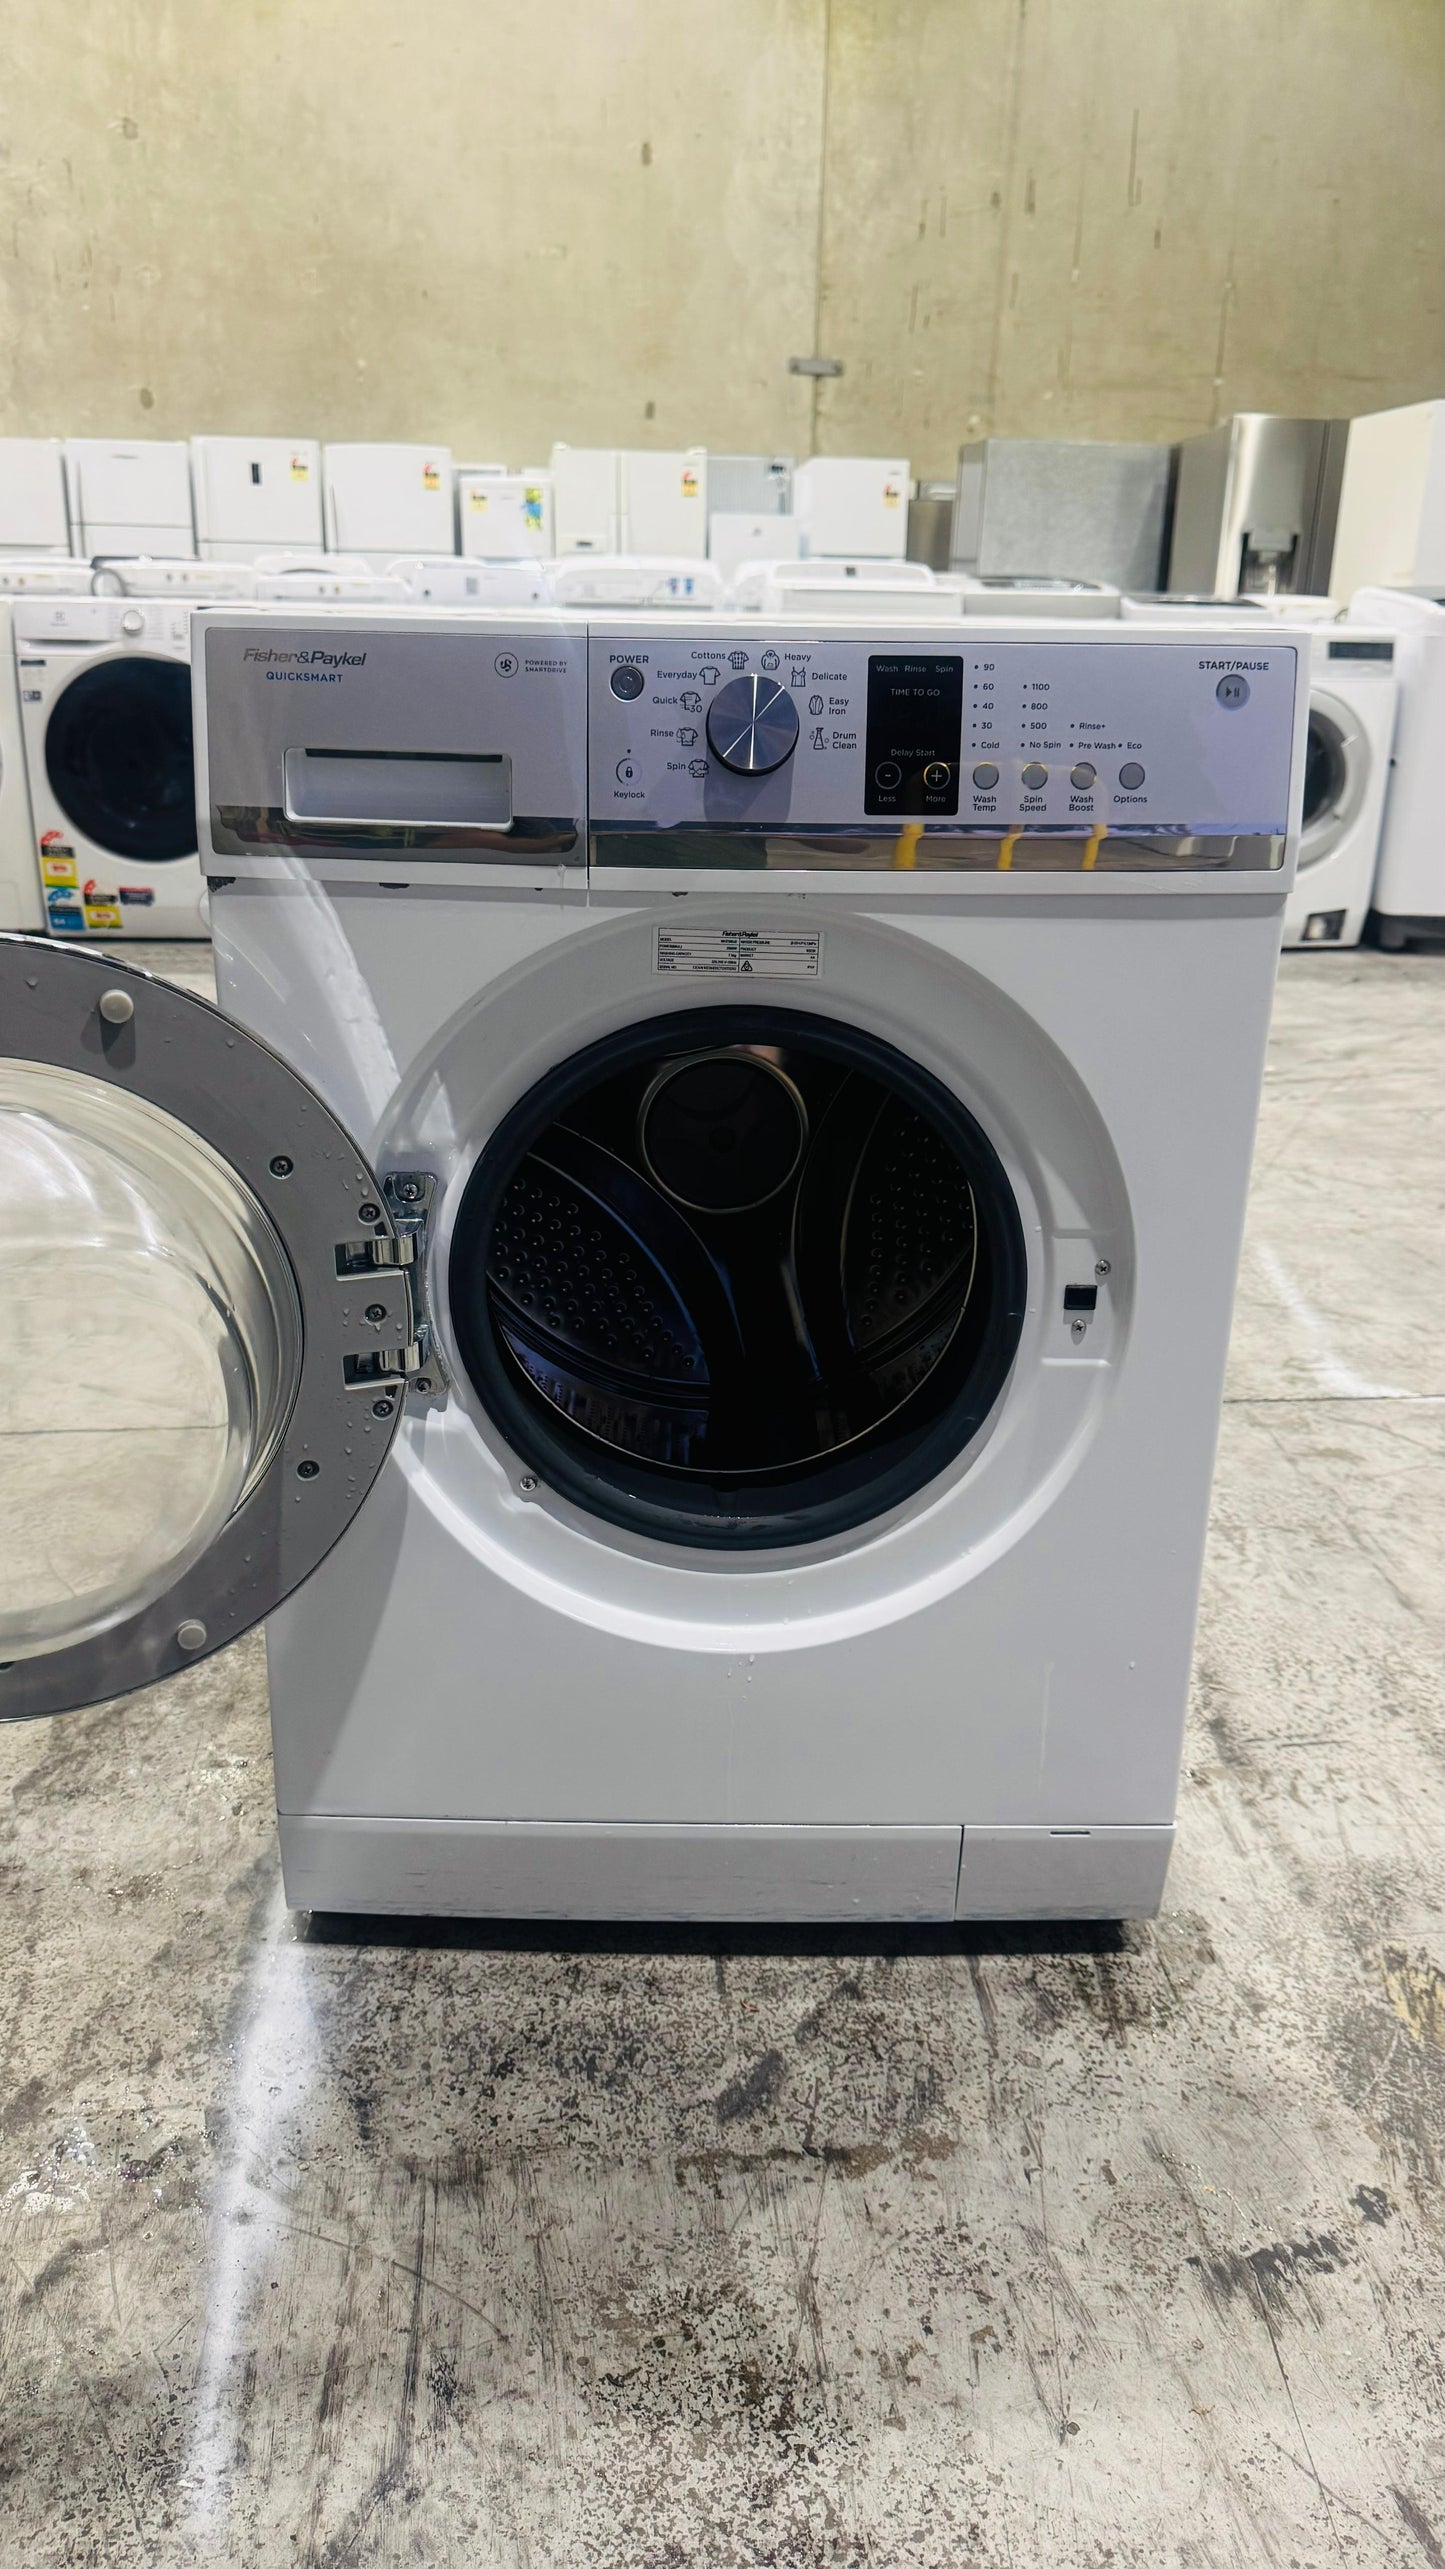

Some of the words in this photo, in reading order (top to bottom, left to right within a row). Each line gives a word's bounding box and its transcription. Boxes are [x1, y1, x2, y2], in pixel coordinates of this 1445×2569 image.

[609, 655, 650, 664] POWER
[691, 651, 726, 661] Cottons
[784, 653, 812, 663] Heavy
[876, 664, 899, 673] Wash
[904, 664, 927, 673] Rinse
[935, 664, 954, 675] Spin
[983, 663, 995, 671] 90
[1198, 661, 1270, 671] START/PAUSE
[266, 671, 344, 683] QUICKSMART
[657, 670, 698, 681] Everyday
[811, 672, 848, 681] Delicate
[982, 683, 994, 691] 60
[1031, 683, 1050, 691] 1100
[890, 688, 911, 697] TIME
[913, 688, 925, 697] TO
[926, 688, 940, 697] GO
[652, 696, 678, 705] Quick
[829, 697, 850, 708] Easy
[982, 702, 994, 710] 40
[1030, 702, 1048, 710] 800
[829, 707, 846, 715] Iron
[981, 721, 993, 730] 30
[1030, 721, 1048, 730] 500
[650, 729, 674, 738] Rinse
[832, 731, 857, 740] Drum
[832, 741, 857, 750] Clean
[981, 740, 1000, 749] Cold
[1029, 740, 1044, 749] No
[1043, 741, 1062, 751] Spin
[890, 748, 912, 759] Delay
[915, 748, 936, 758] Start
[667, 762, 686, 772] Spin
[613, 790, 646, 800] Keylock
[878, 795, 897, 803] Less
[925, 795, 946, 803] More
[972, 795, 997, 803] Wash
[1070, 795, 1094, 803] Wash
[1113, 795, 1148, 804] Options
[1023, 795, 1043, 805] Spin
[972, 803, 997, 813] Temp
[1019, 803, 1047, 813] Speed
[1068, 804, 1094, 812] Boost
